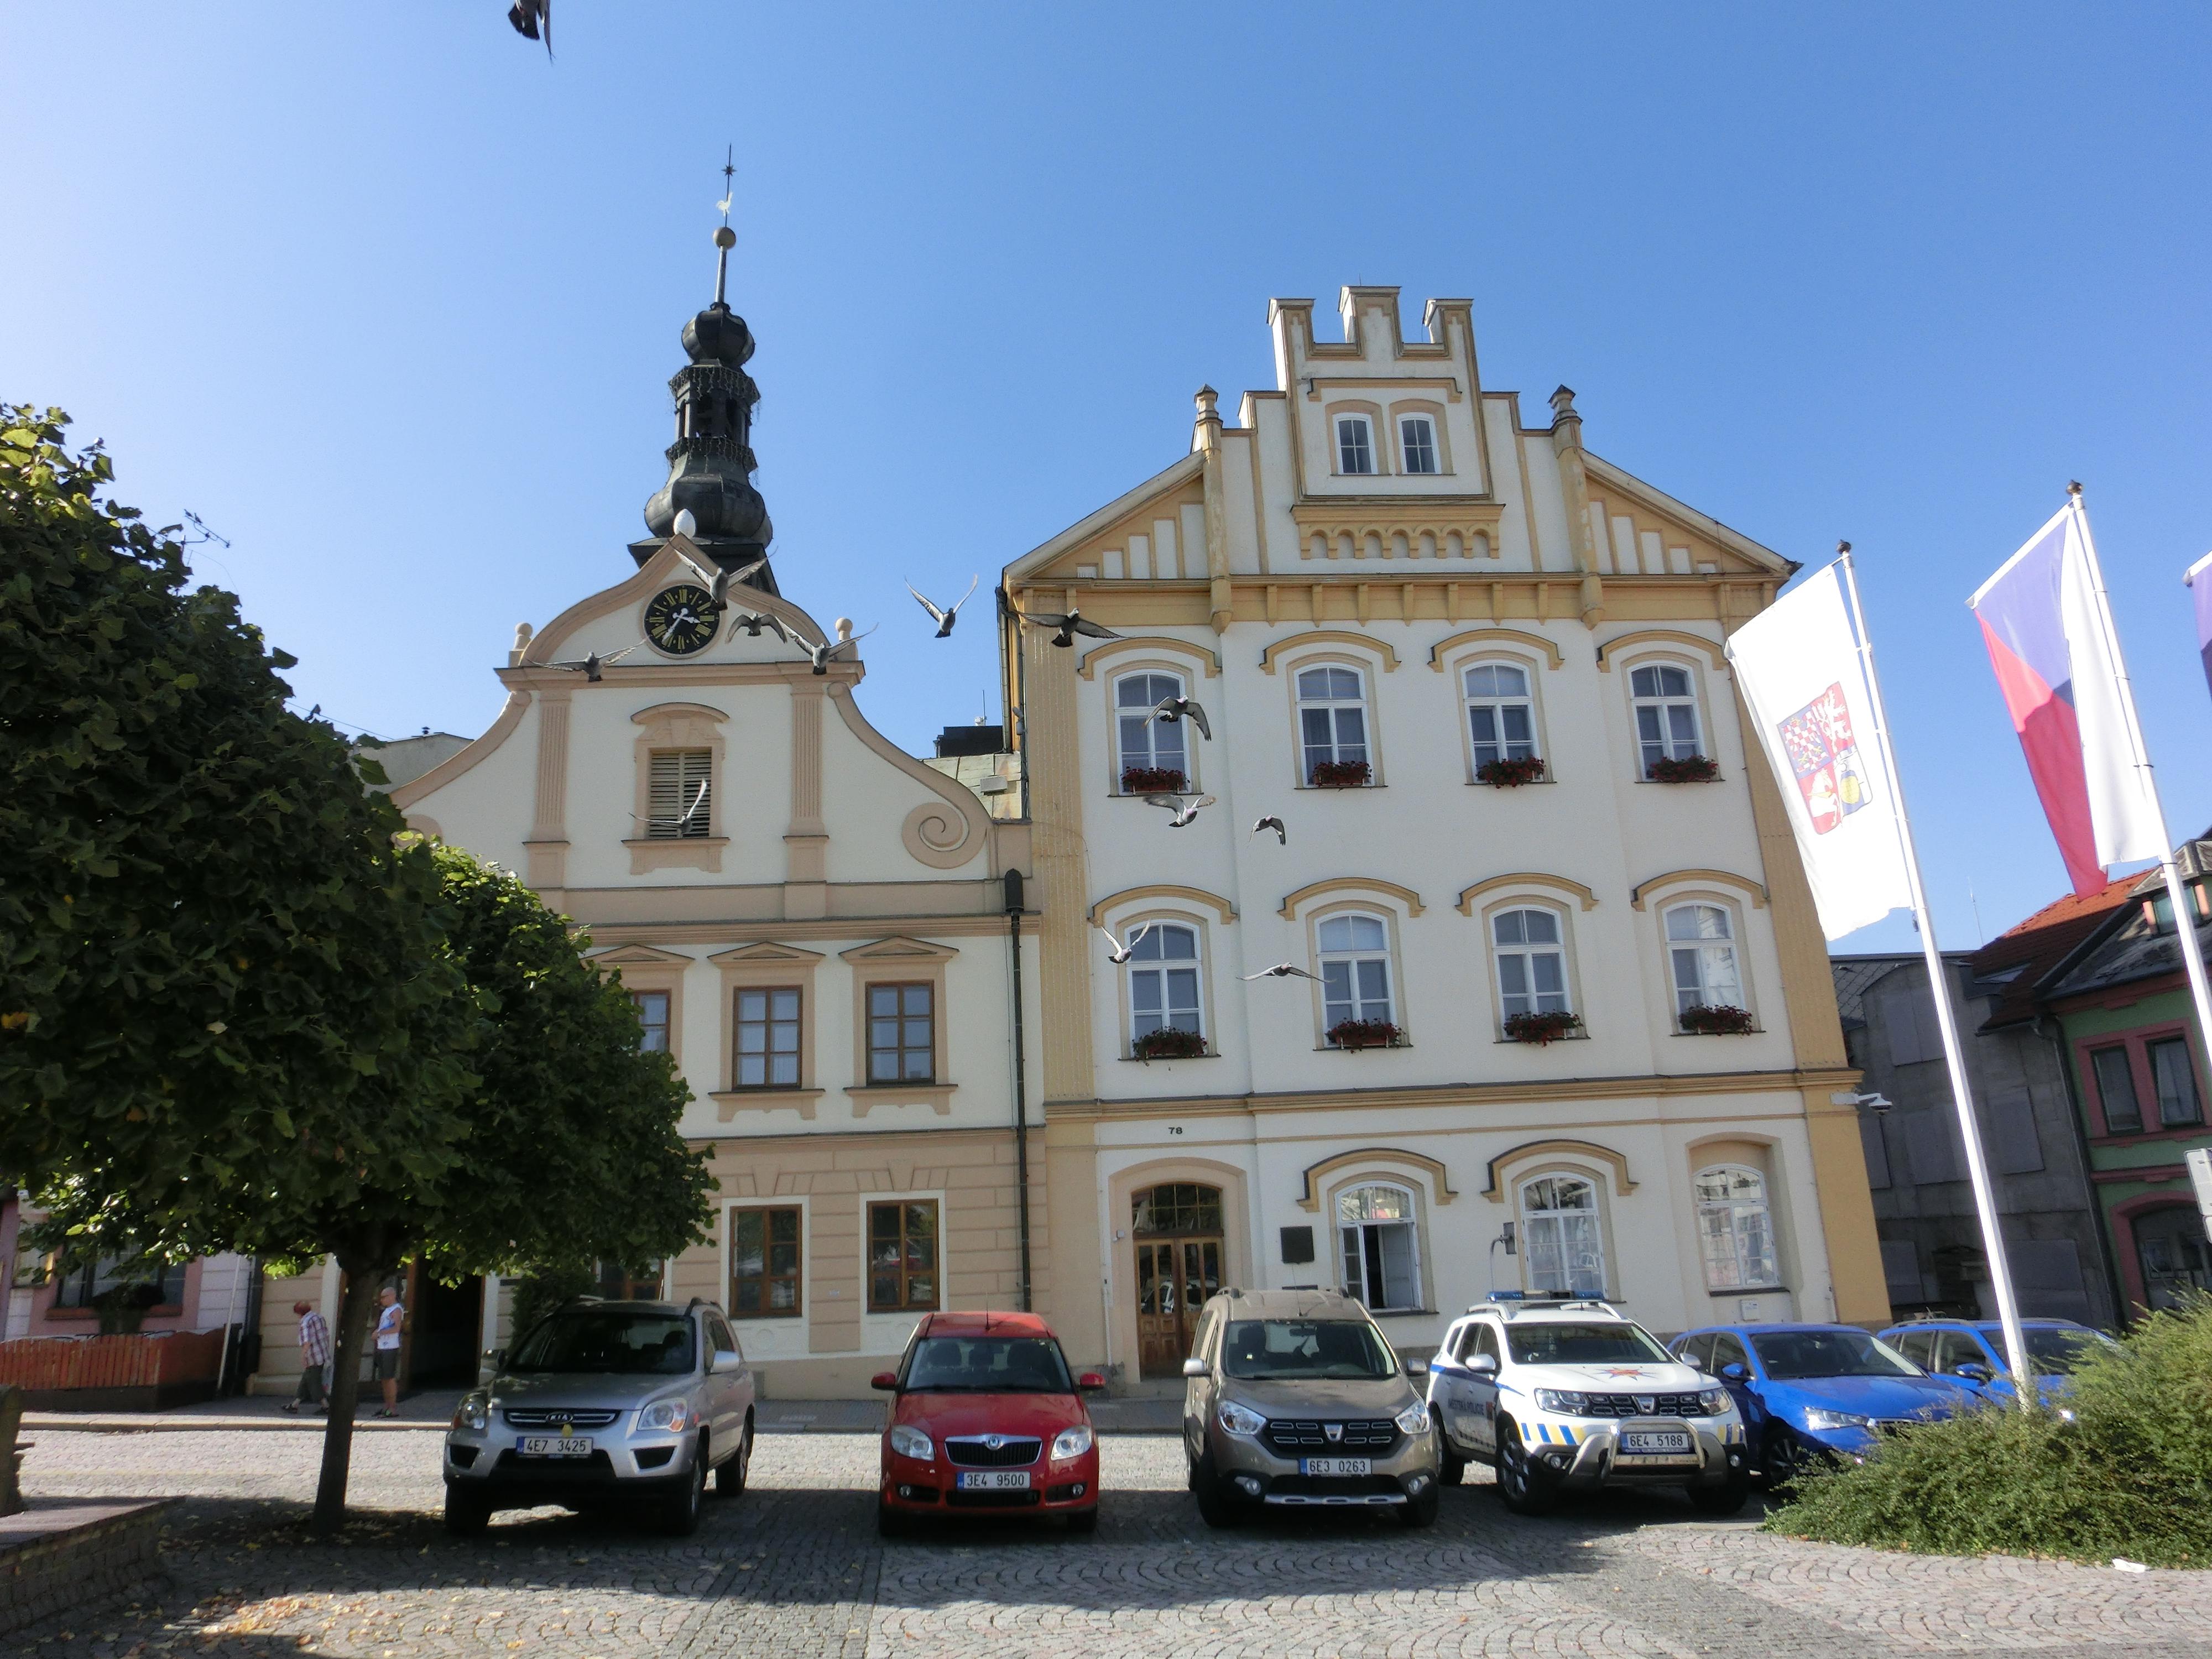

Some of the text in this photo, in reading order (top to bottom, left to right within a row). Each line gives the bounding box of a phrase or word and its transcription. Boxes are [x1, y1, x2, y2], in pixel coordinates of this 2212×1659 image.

[527, 1439, 549, 1452] 4E7
[557, 1439, 586, 1452] 3425
[1630, 1435, 1649, 1447] 6E4
[1657, 1435, 1683, 1447] 5188
[1310, 1460, 1330, 1472] 6E3
[1339, 1460, 1365, 1472] 0263
[967, 1474, 987, 1486] 3E4
[997, 1474, 1024, 1486] 9500
